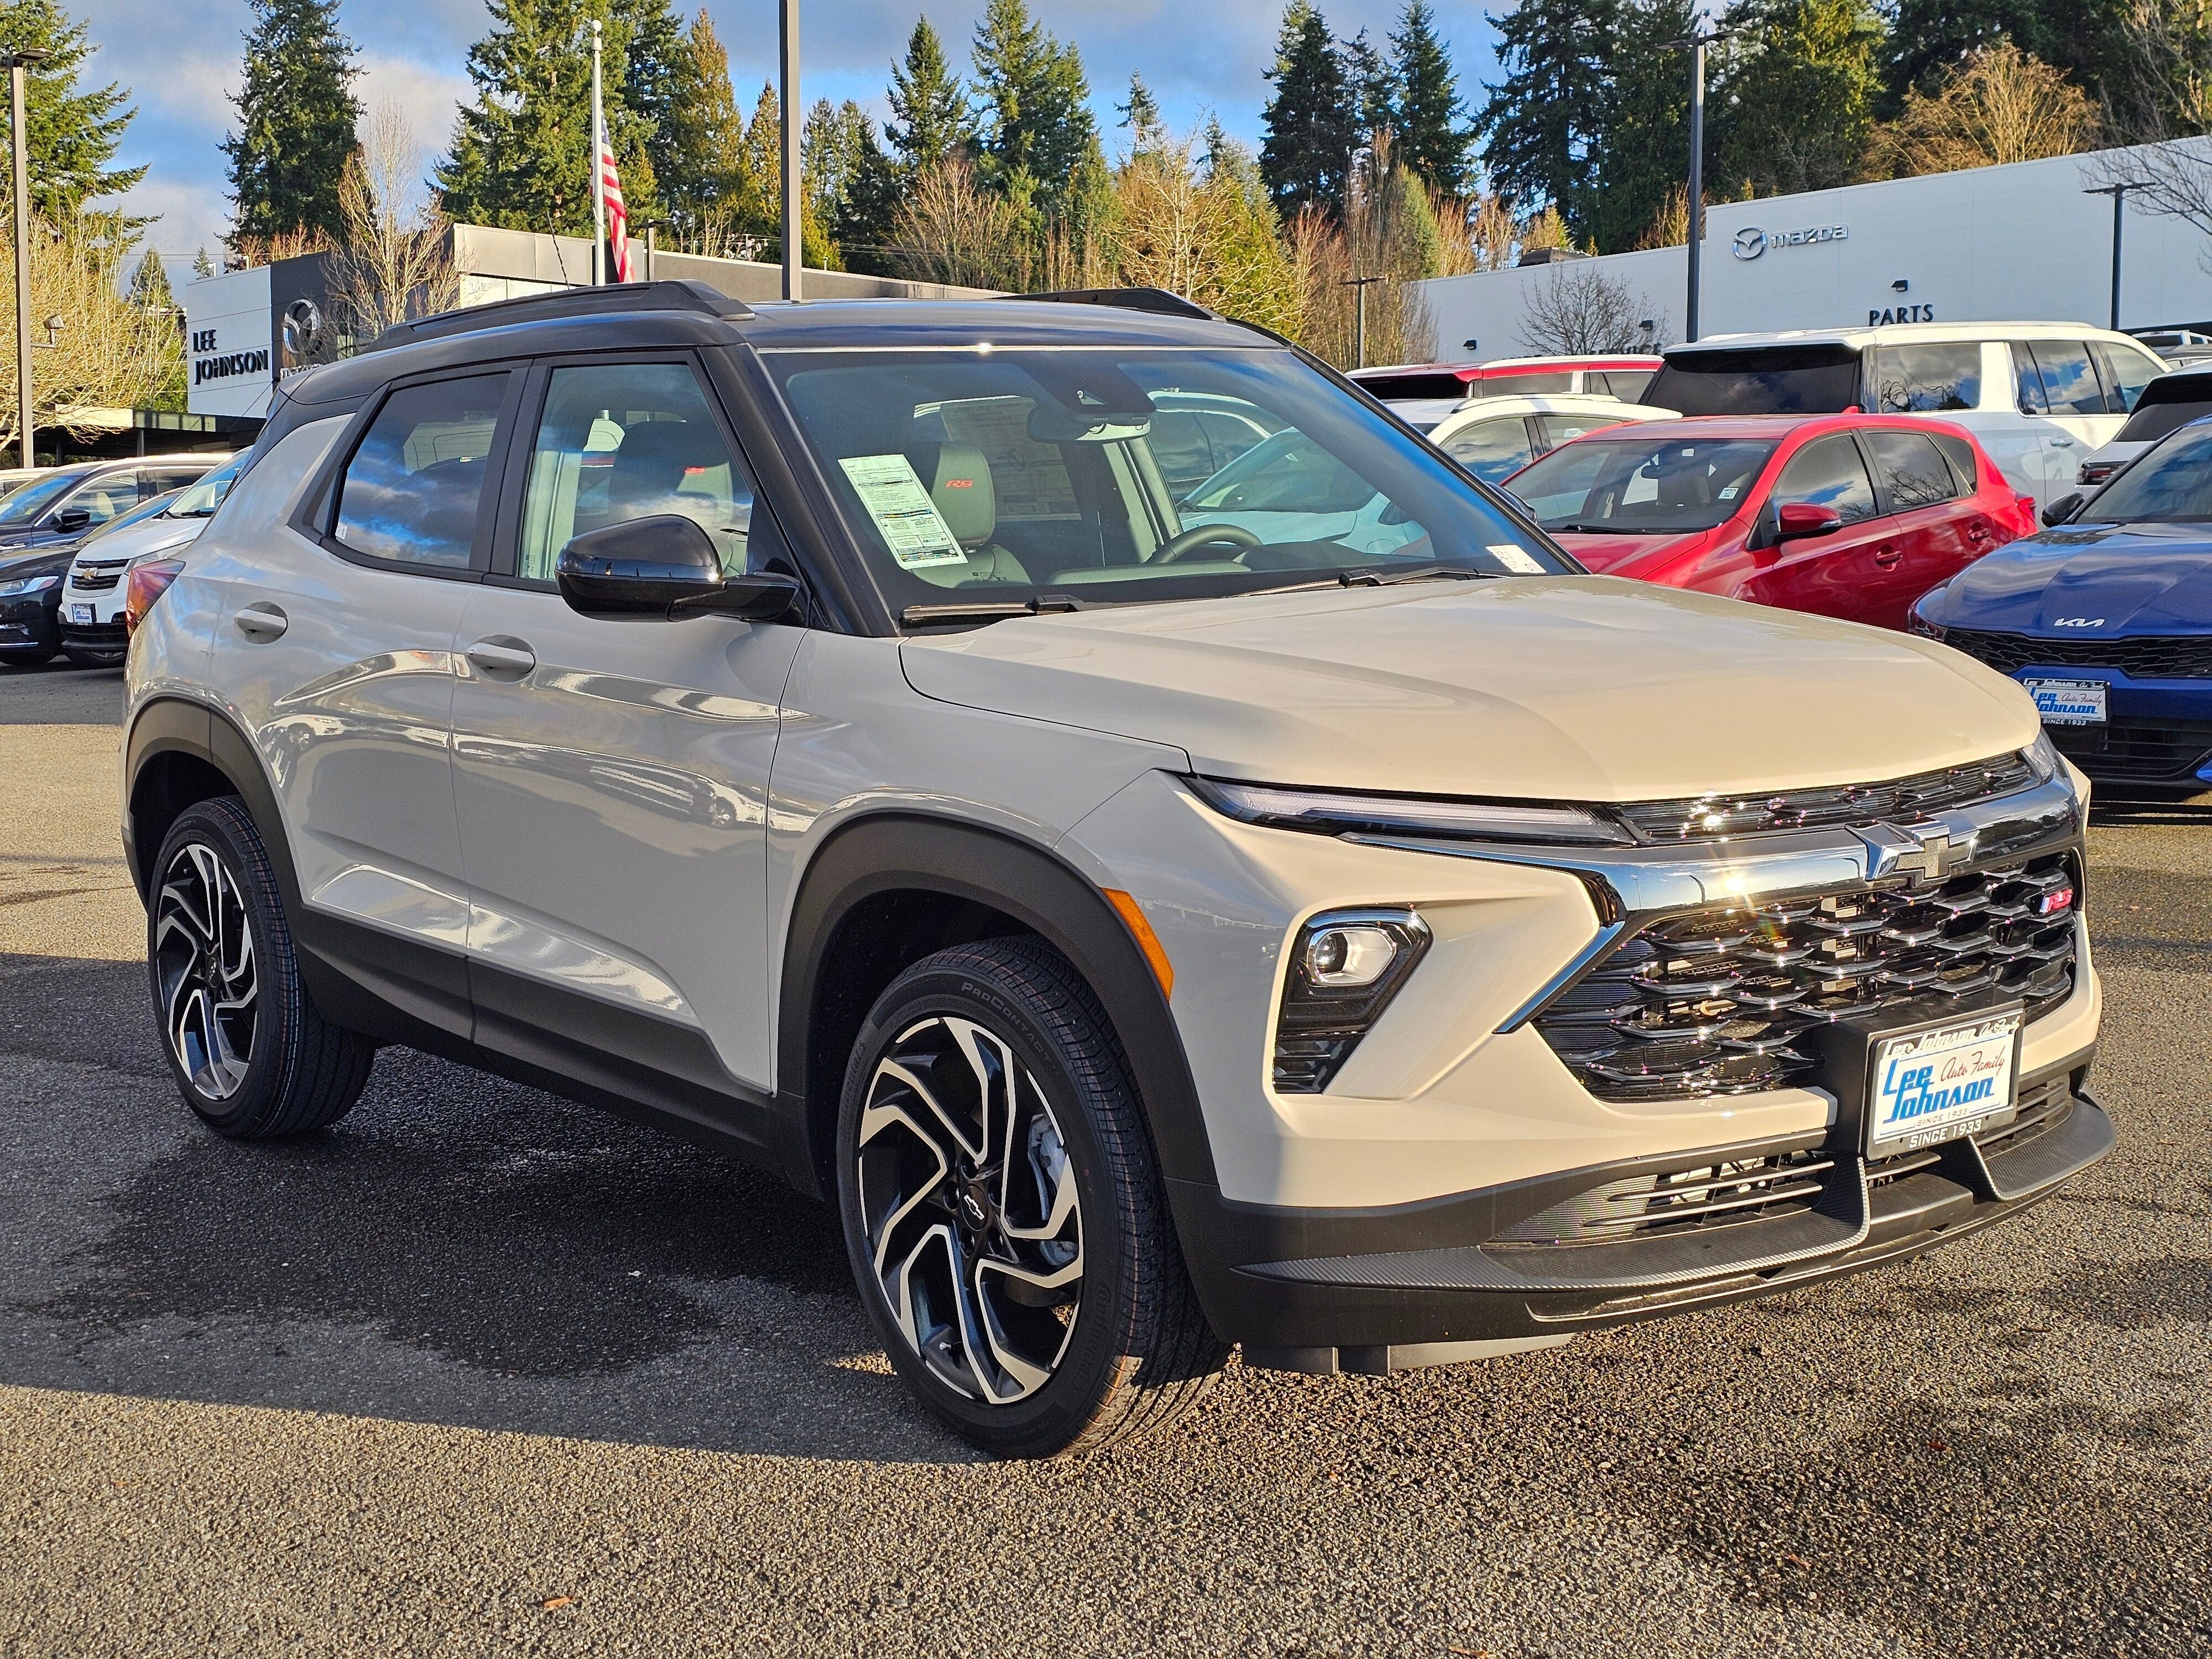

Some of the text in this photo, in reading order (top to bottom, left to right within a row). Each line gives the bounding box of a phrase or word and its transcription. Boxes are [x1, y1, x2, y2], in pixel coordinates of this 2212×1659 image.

[1771, 224, 1849, 248] mazda
[1869, 303, 1933, 327] PARTS
[192, 329, 217, 352] LEE
[194, 349, 269, 385] JOHNSON
[945, 479, 974, 488] RS
[2079, 693, 2103, 706] Family
[2046, 888, 2073, 913] RS
[1882, 1045, 2006, 1096] Lee Auto Family
[1882, 1074, 1995, 1124] Johnson
[1915, 1108, 1969, 1126] SINCE 1933
[1909, 1118, 1982, 1149] SINCE 1933
